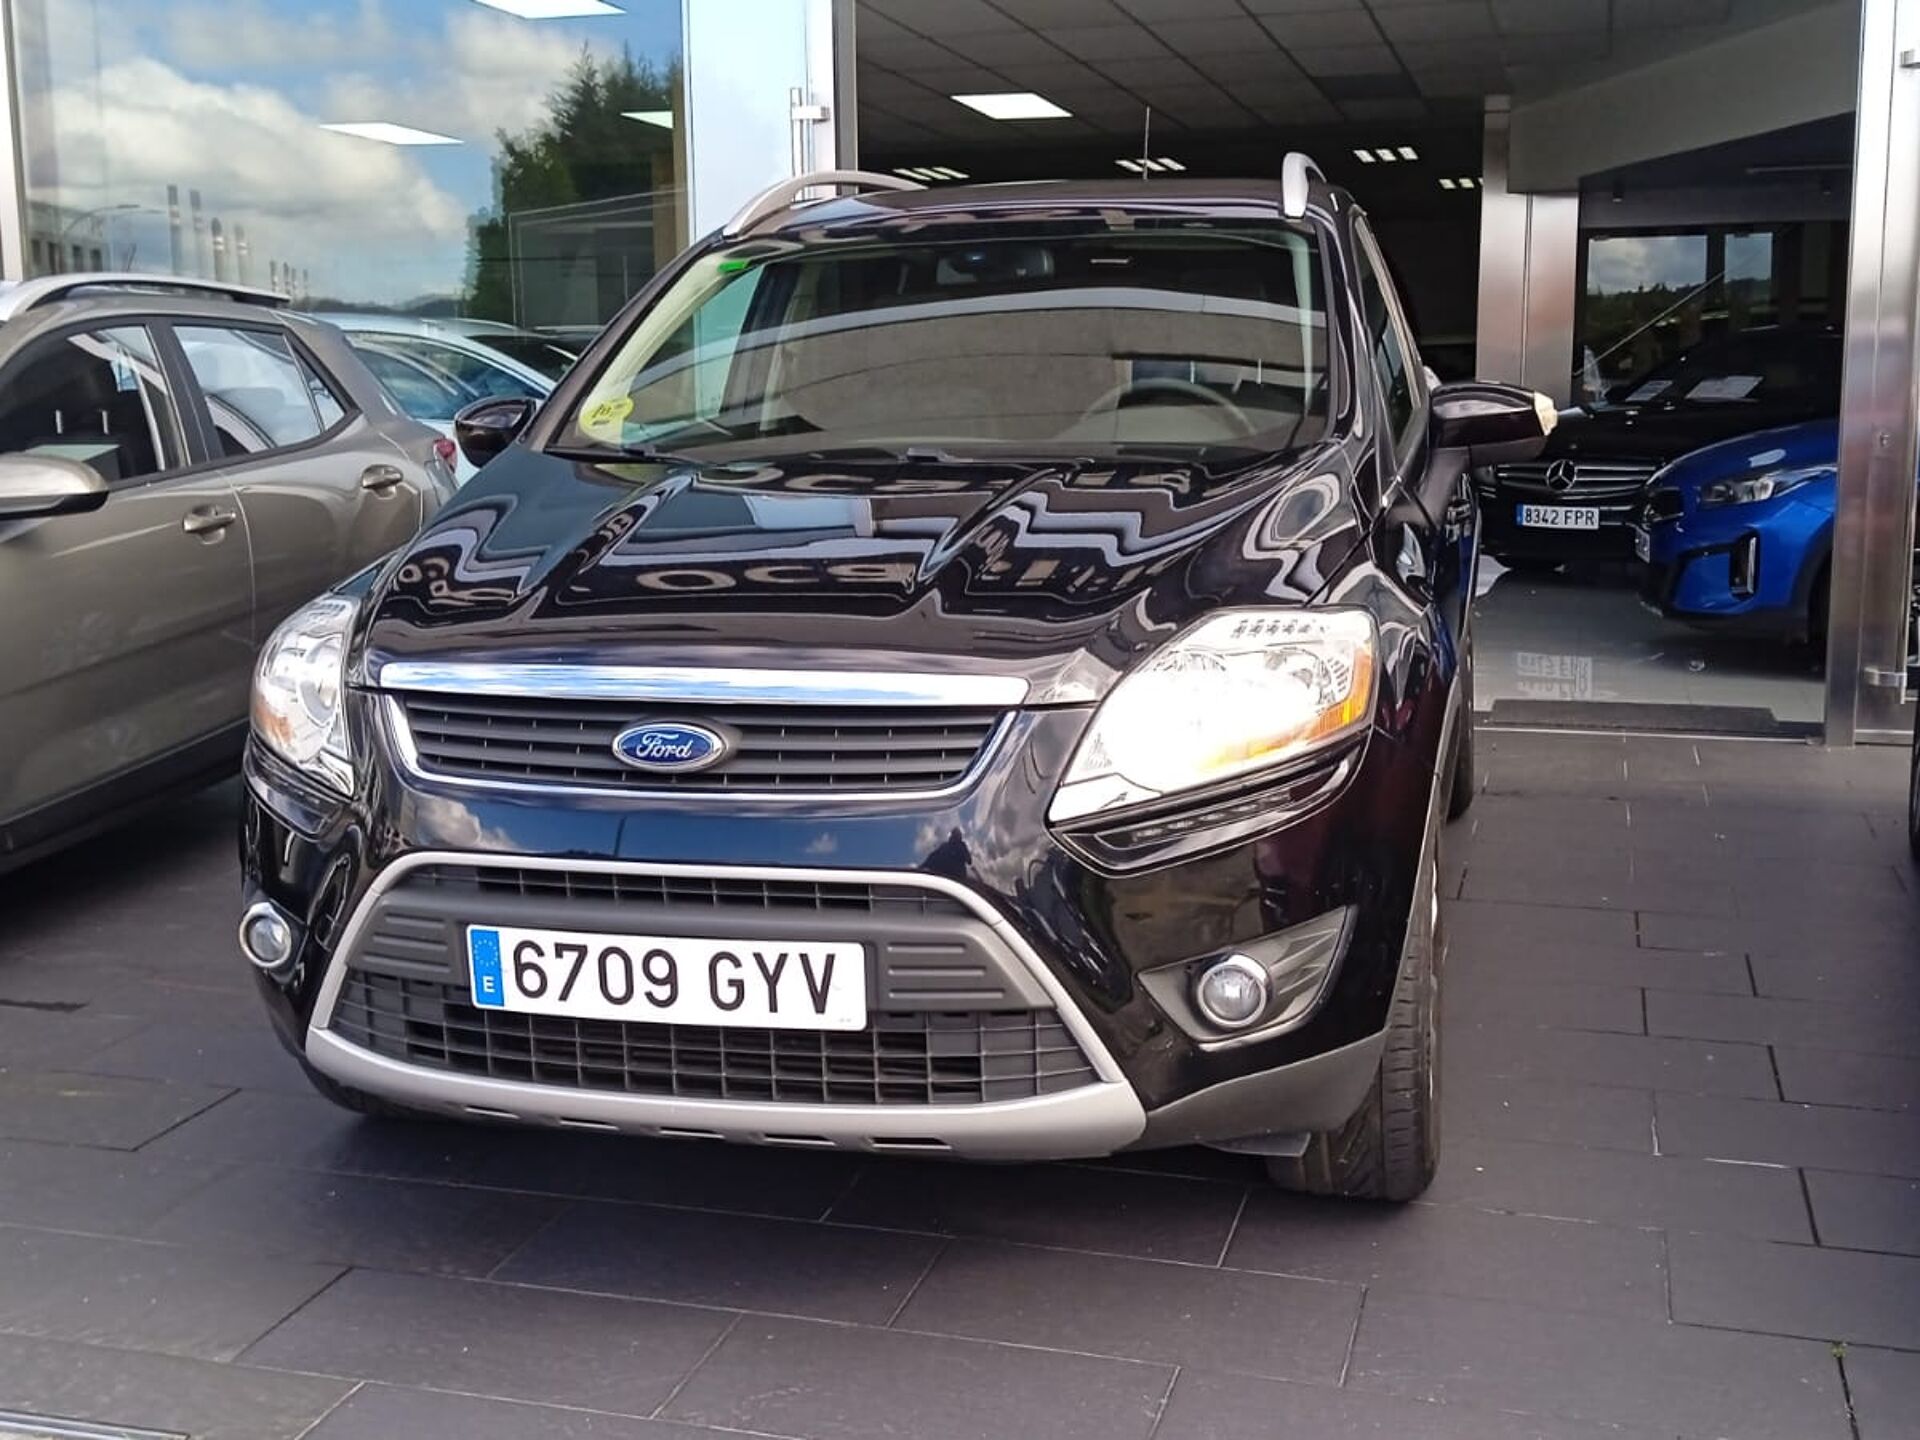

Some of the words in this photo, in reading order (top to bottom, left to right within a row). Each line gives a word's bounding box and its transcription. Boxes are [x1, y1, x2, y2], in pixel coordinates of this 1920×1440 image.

[1524, 508, 1560, 525] 8342
[1563, 509, 1595, 526] FPR
[636, 732, 694, 758] Ford
[482, 975, 496, 993] E
[513, 940, 679, 1009] 6709
[708, 951, 836, 1015] GYV
